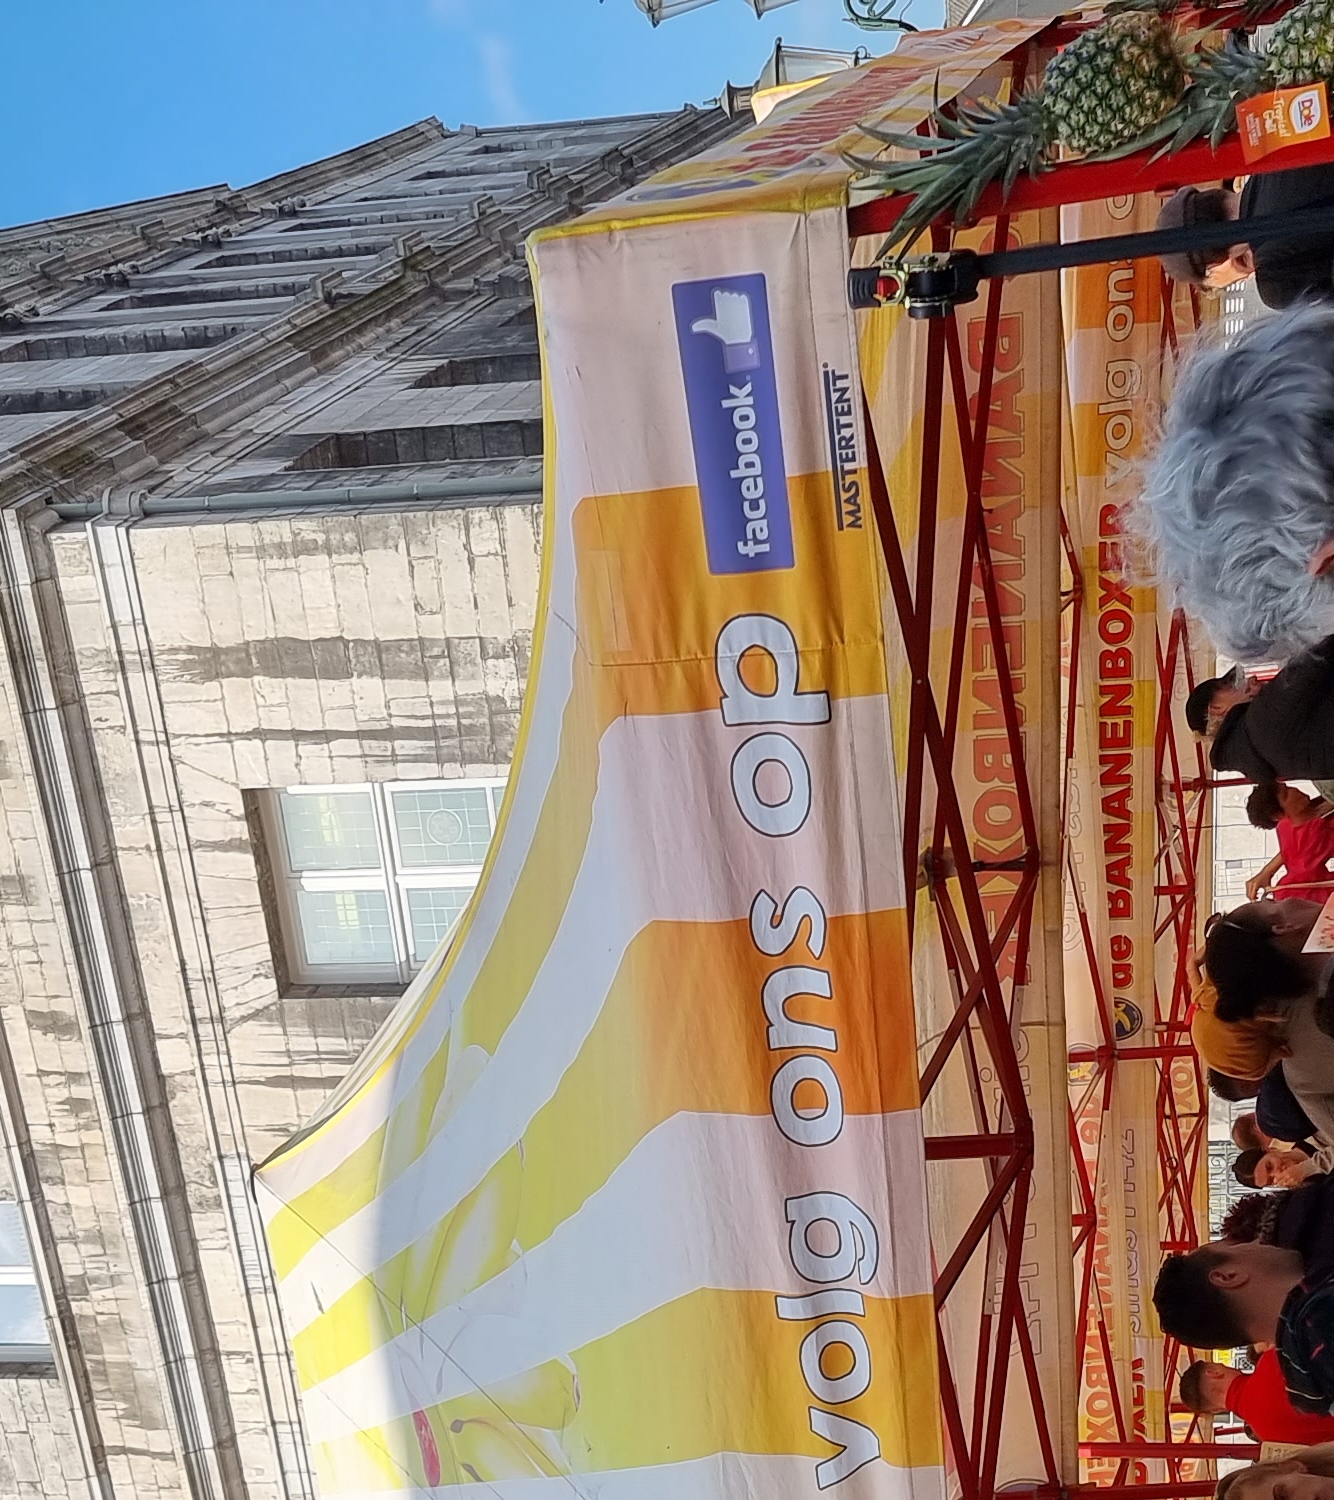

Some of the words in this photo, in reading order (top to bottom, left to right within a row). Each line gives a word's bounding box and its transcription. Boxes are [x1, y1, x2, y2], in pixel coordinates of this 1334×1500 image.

[1300, 98, 1316, 127] Dole
[1103, 258, 1136, 342] on
[721, 382, 770, 558] facebook
[831, 368, 863, 529] MASTERTENT
[1097, 358, 1142, 489] volg
[714, 612, 831, 838] op
[1097, 502, 1135, 920] BANANENBOXER
[747, 884, 845, 1148] ons
[775, 1190, 879, 1489] volg
